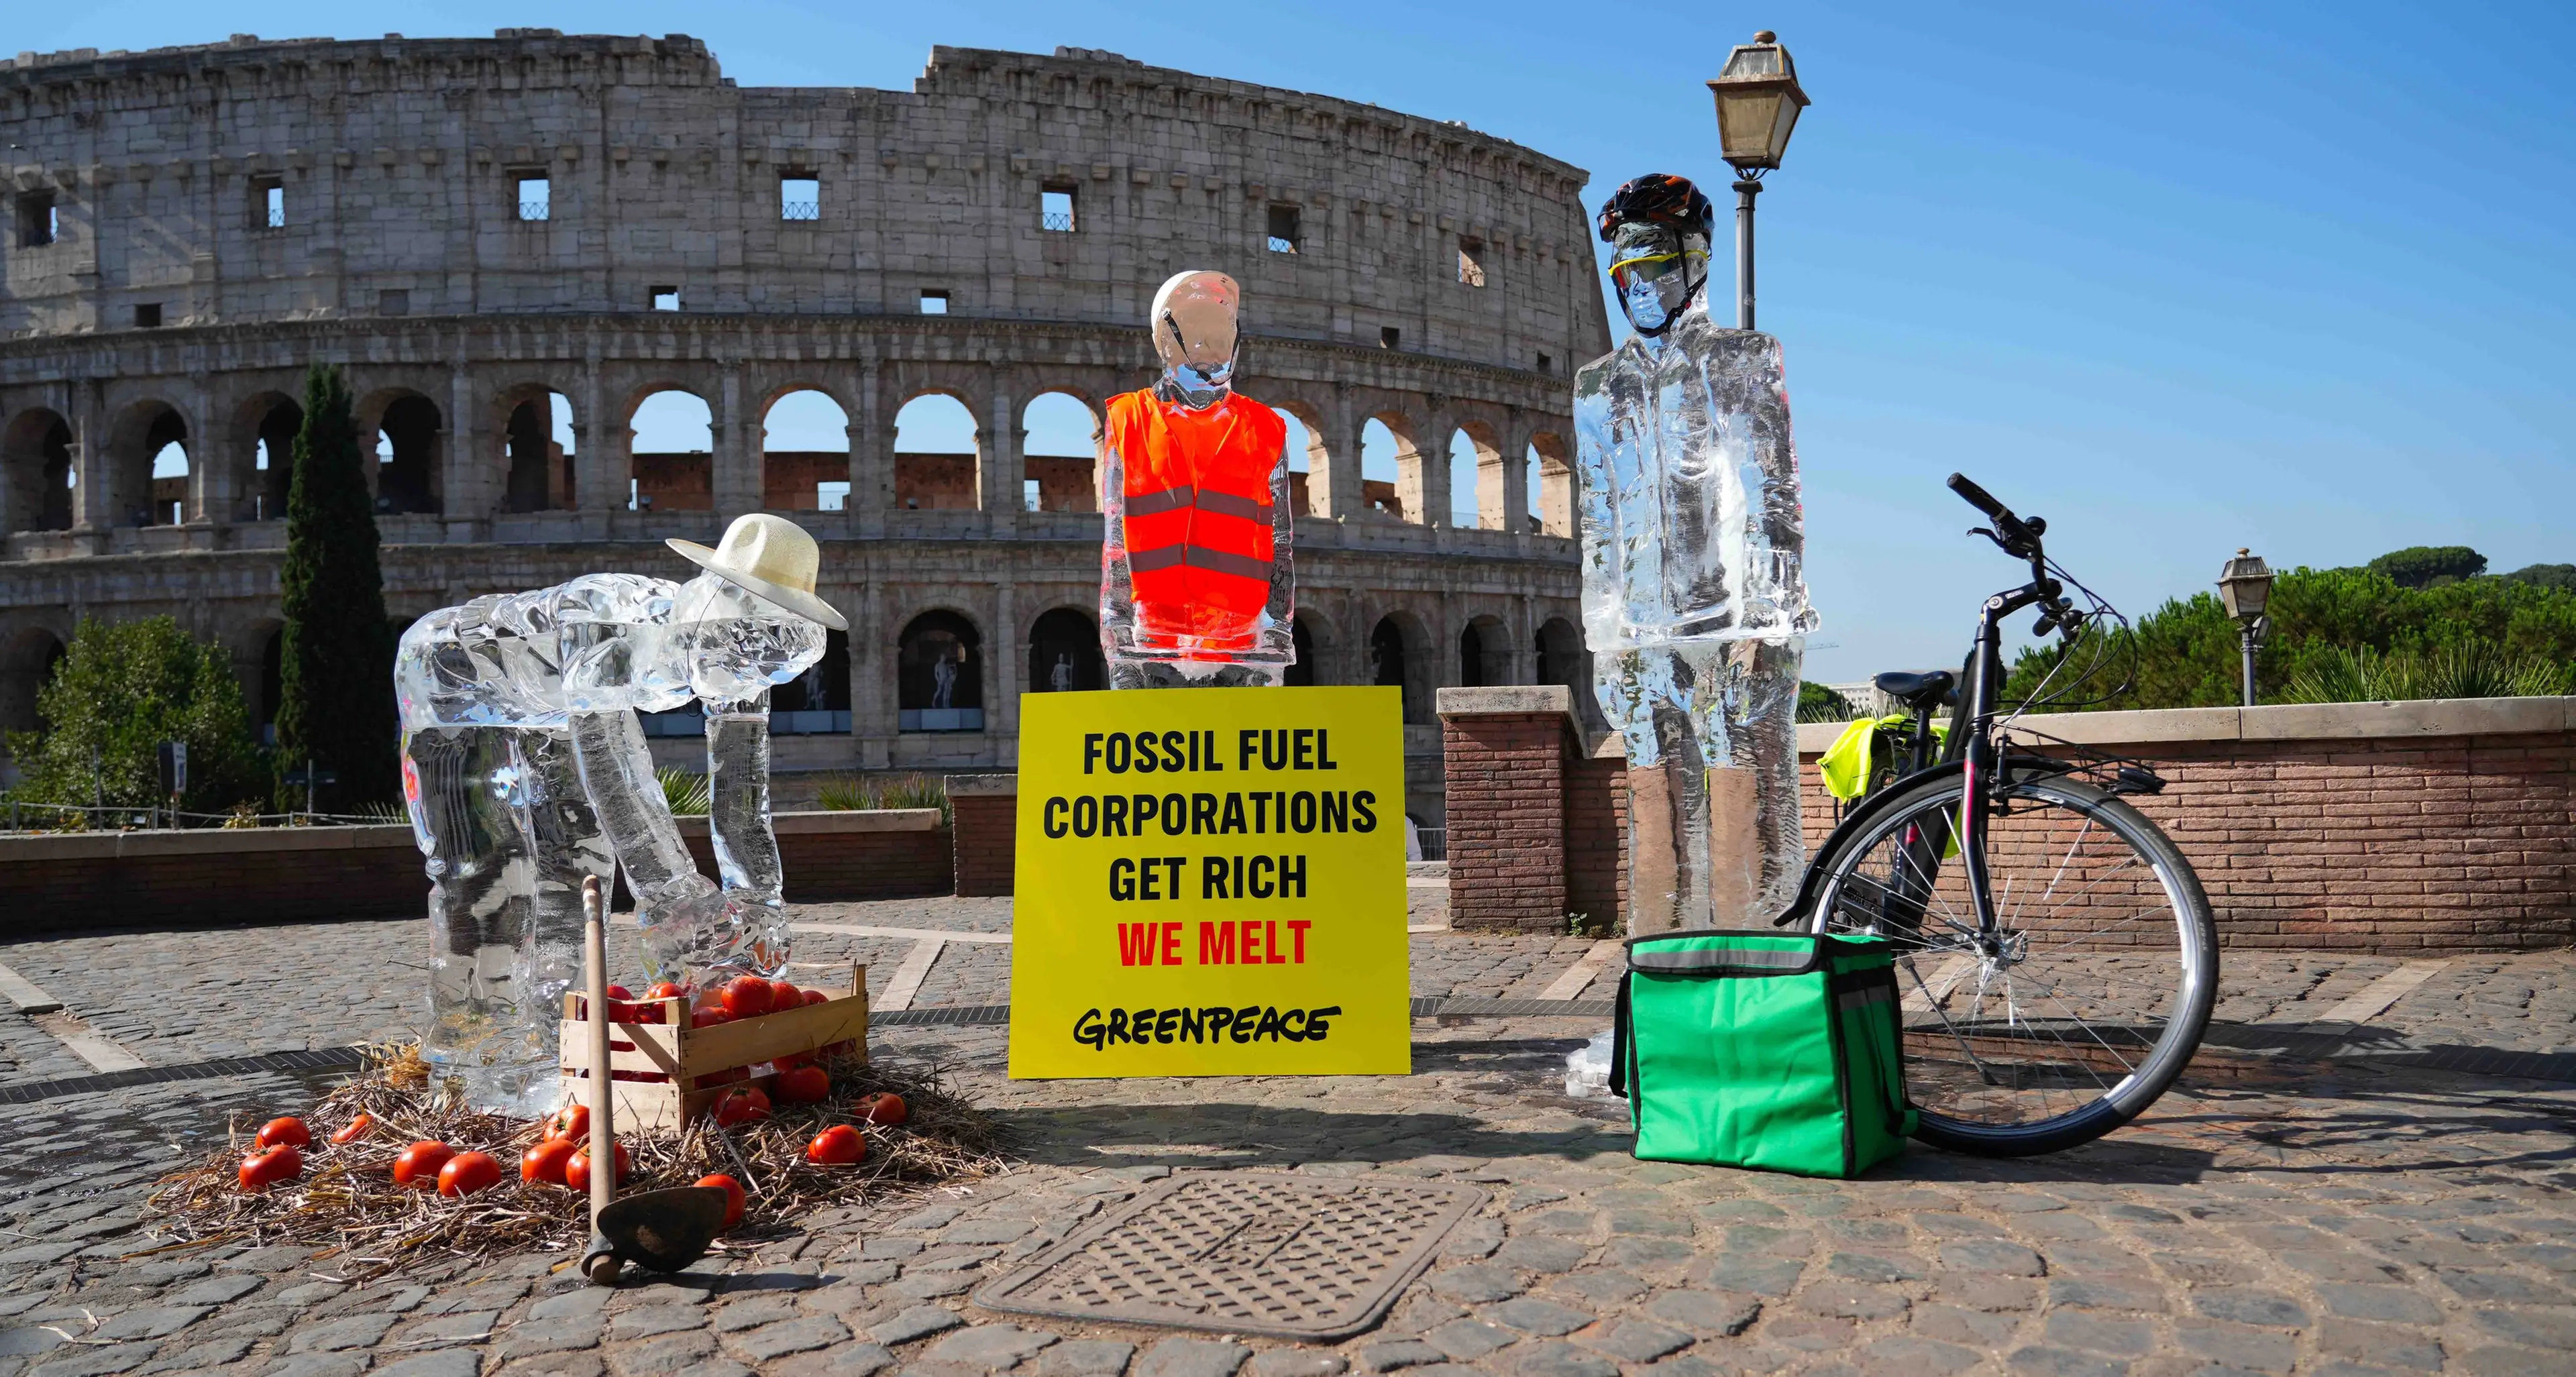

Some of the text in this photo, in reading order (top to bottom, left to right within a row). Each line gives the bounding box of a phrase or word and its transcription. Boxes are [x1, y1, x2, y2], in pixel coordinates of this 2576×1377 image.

[1084, 729, 1337, 774] FOSSIL FUEL
[1044, 791, 1377, 838] CORPORATIONS
[1110, 855, 1306, 901] GET RICH
[1118, 920, 1311, 966] WE MELT
[1073, 1005, 1342, 1051] GREENPEACE
